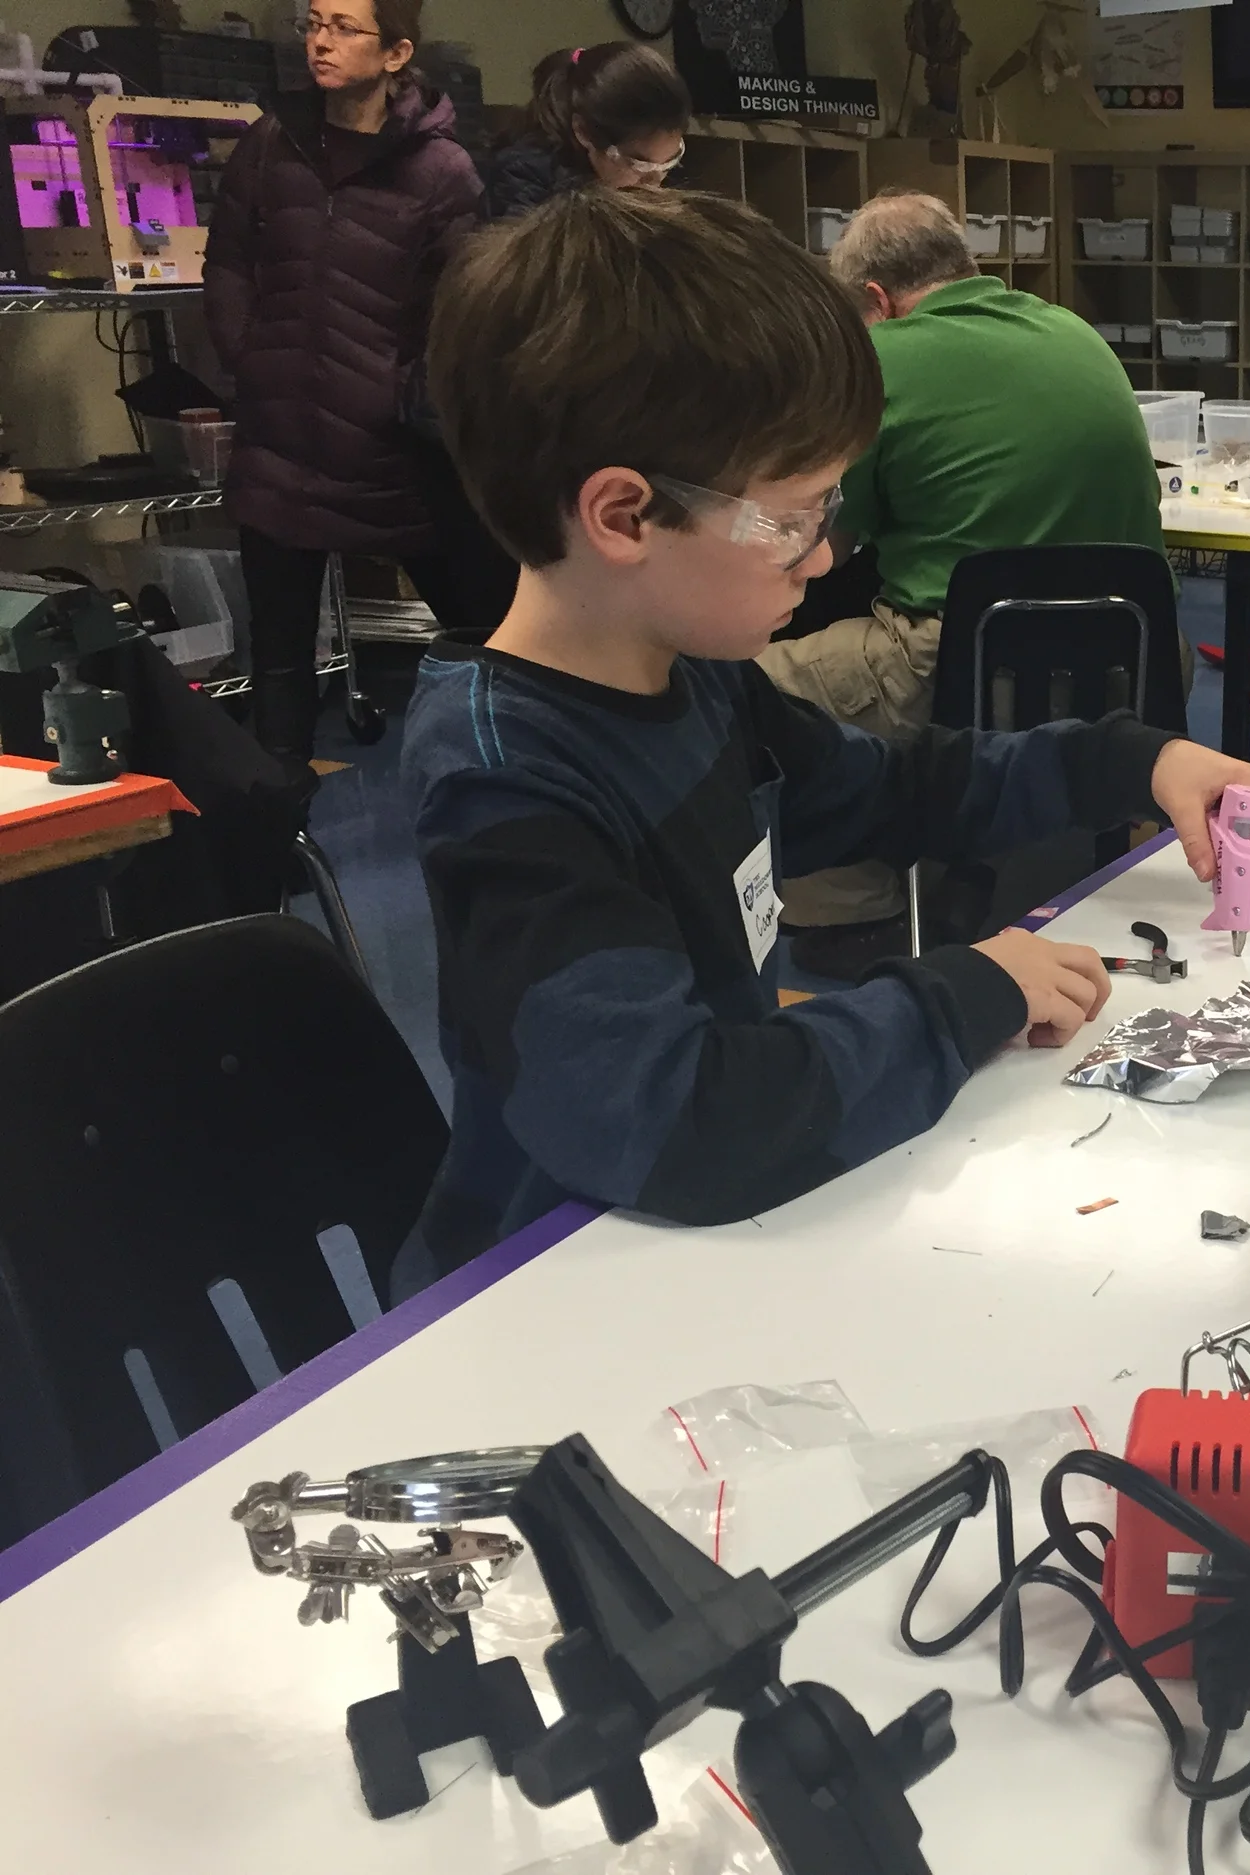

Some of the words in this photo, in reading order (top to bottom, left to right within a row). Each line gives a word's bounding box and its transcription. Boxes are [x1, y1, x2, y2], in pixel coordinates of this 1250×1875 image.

[738, 76, 801, 93] MAKING
[805, 81, 816, 94] &
[740, 96, 800, 112] DESIGN
[803, 100, 877, 117] THINKING
